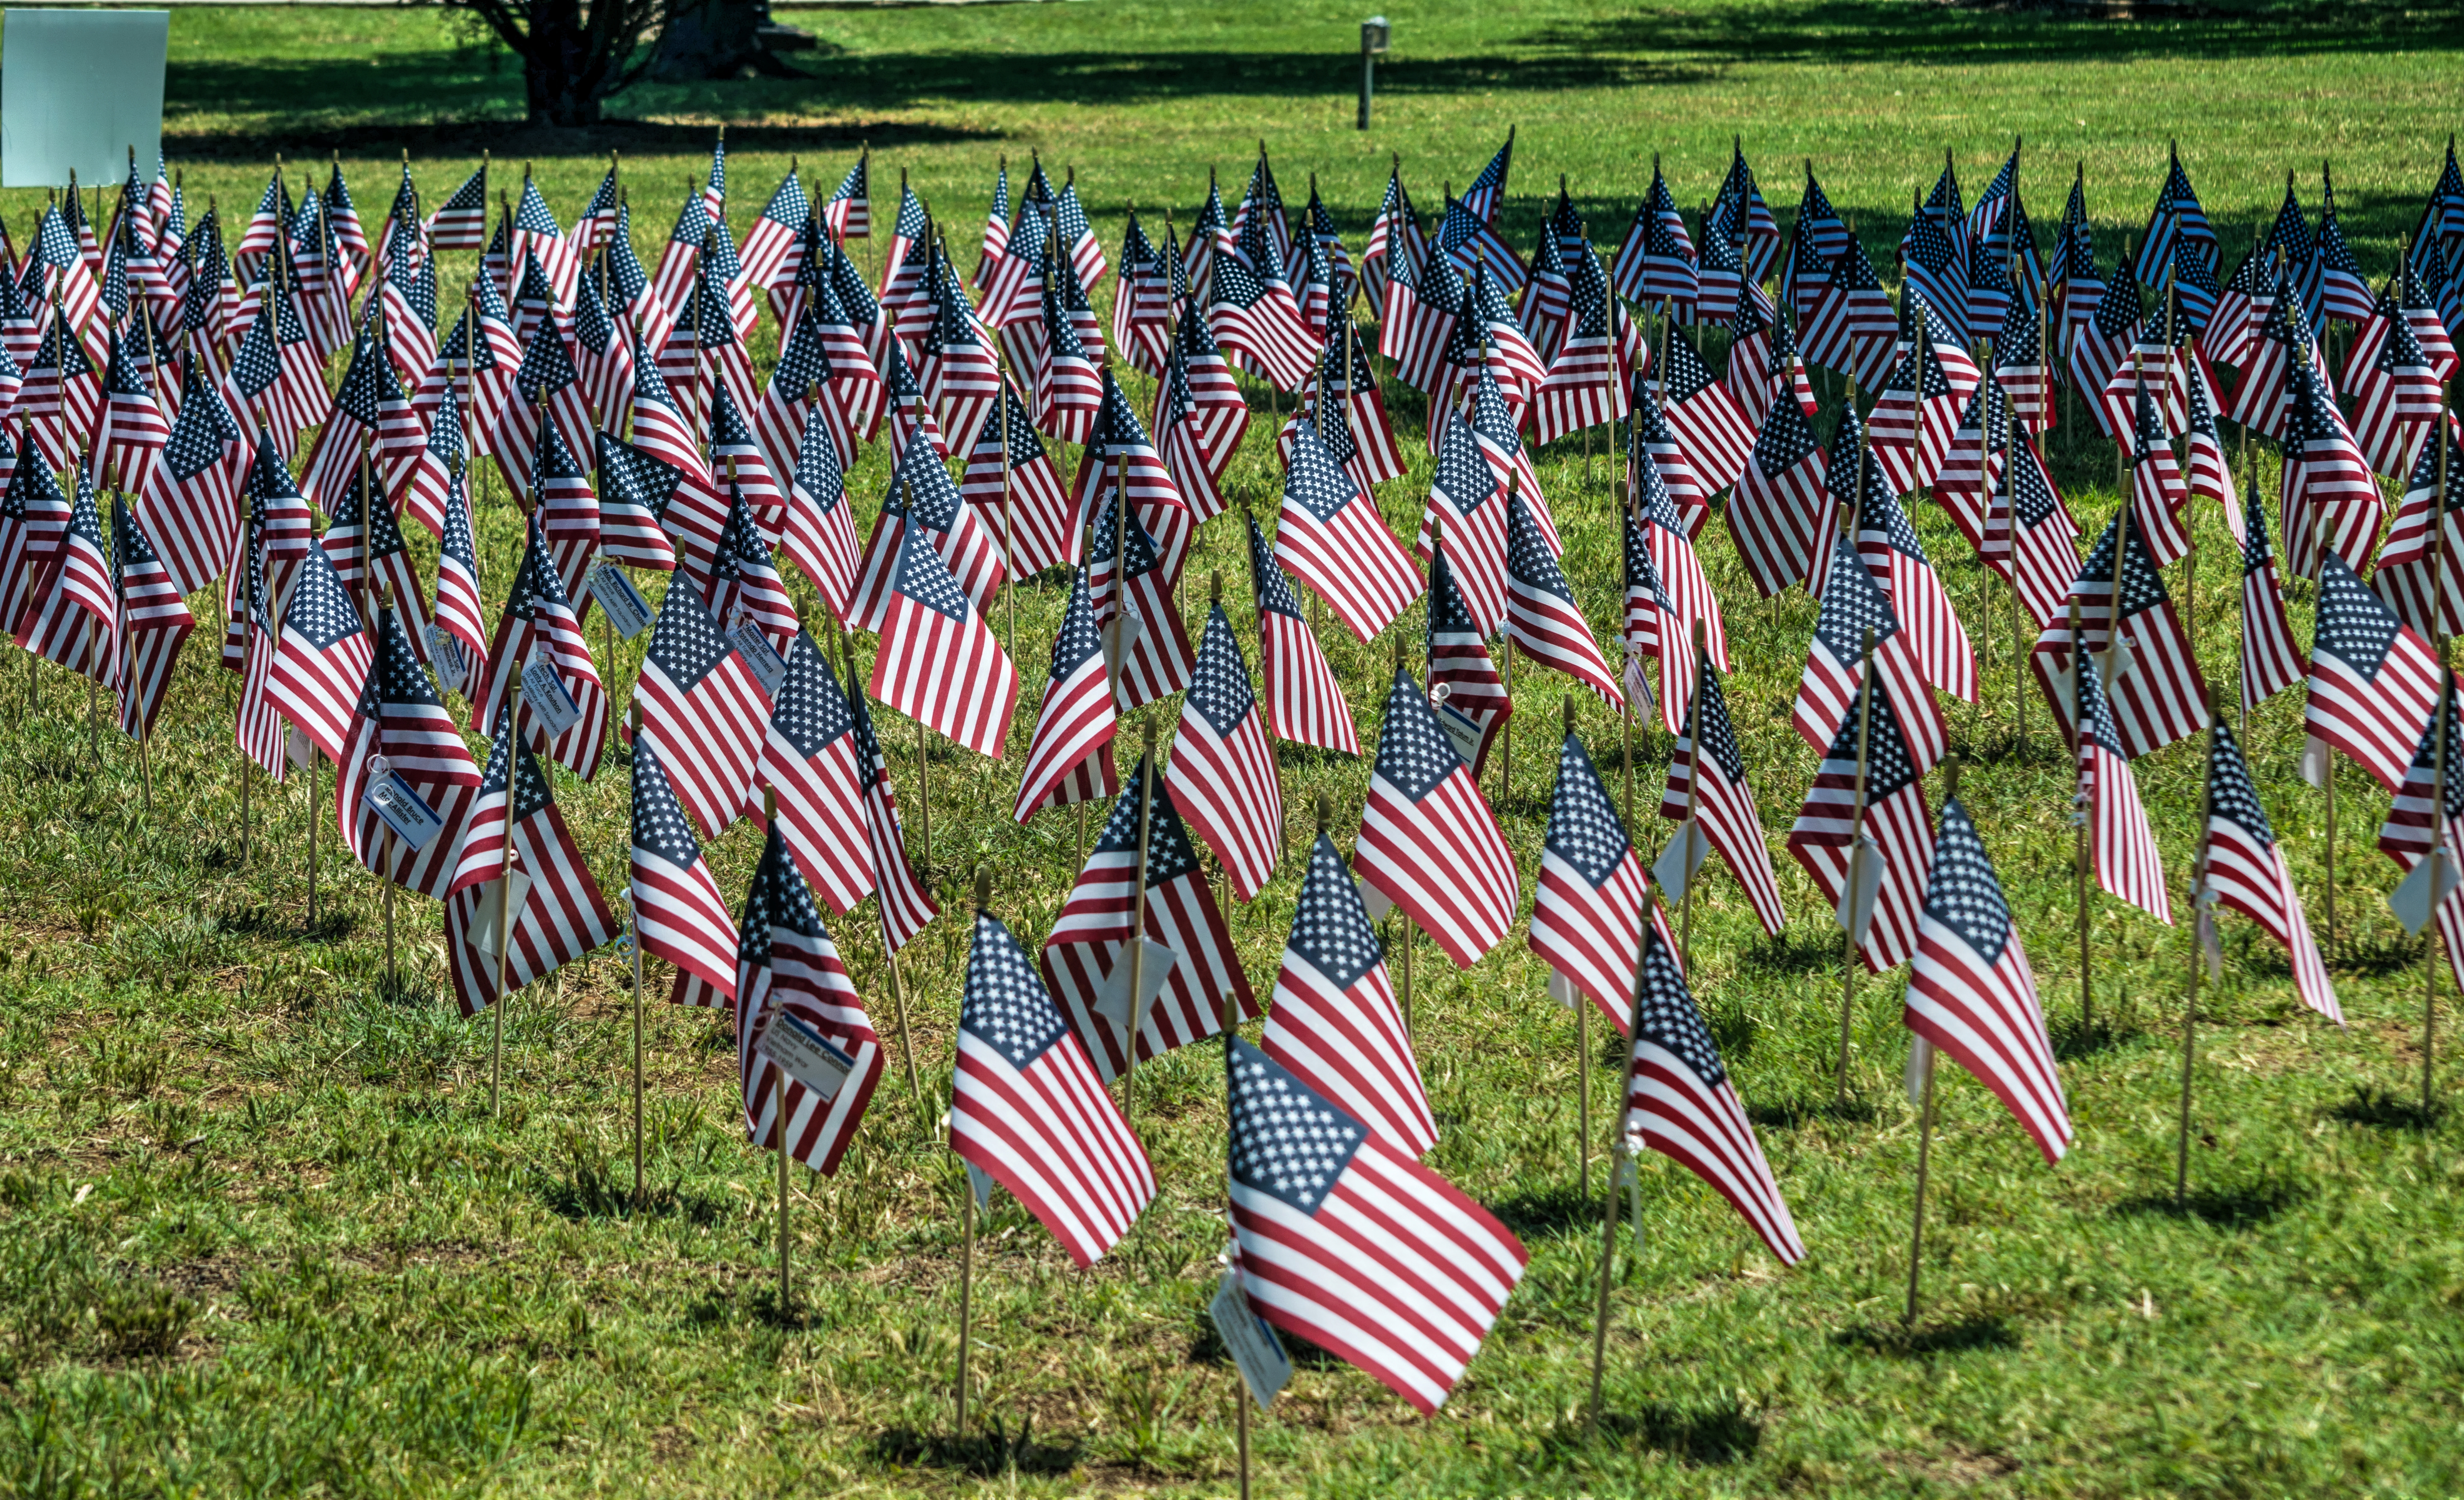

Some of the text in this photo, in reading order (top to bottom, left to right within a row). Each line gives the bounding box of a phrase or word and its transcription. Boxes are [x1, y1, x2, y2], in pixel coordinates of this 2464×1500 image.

[598, 583, 610, 599] Military
[608, 598, 618, 608] Airlift
[605, 582, 615, 595] Force
[612, 581, 629, 602] Richard
[627, 601, 634, 609] W.
[632, 608, 646, 627] Chase
[737, 629, 773, 672] Rosendo Herrera
[742, 645, 752, 658] Force
[747, 662, 757, 672] Airlift
[524, 691, 534, 704] Chief
[527, 685, 538, 701] Military
[537, 701, 546, 712] Airlift
[531, 667, 543, 683] Lonty
[545, 690, 562, 713] Knutson
[534, 684, 543, 697] Force
[379, 791, 411, 824] MacAllister
[386, 784, 424, 824] Donald Bruce
[805, 1038, 821, 1053] Lee
